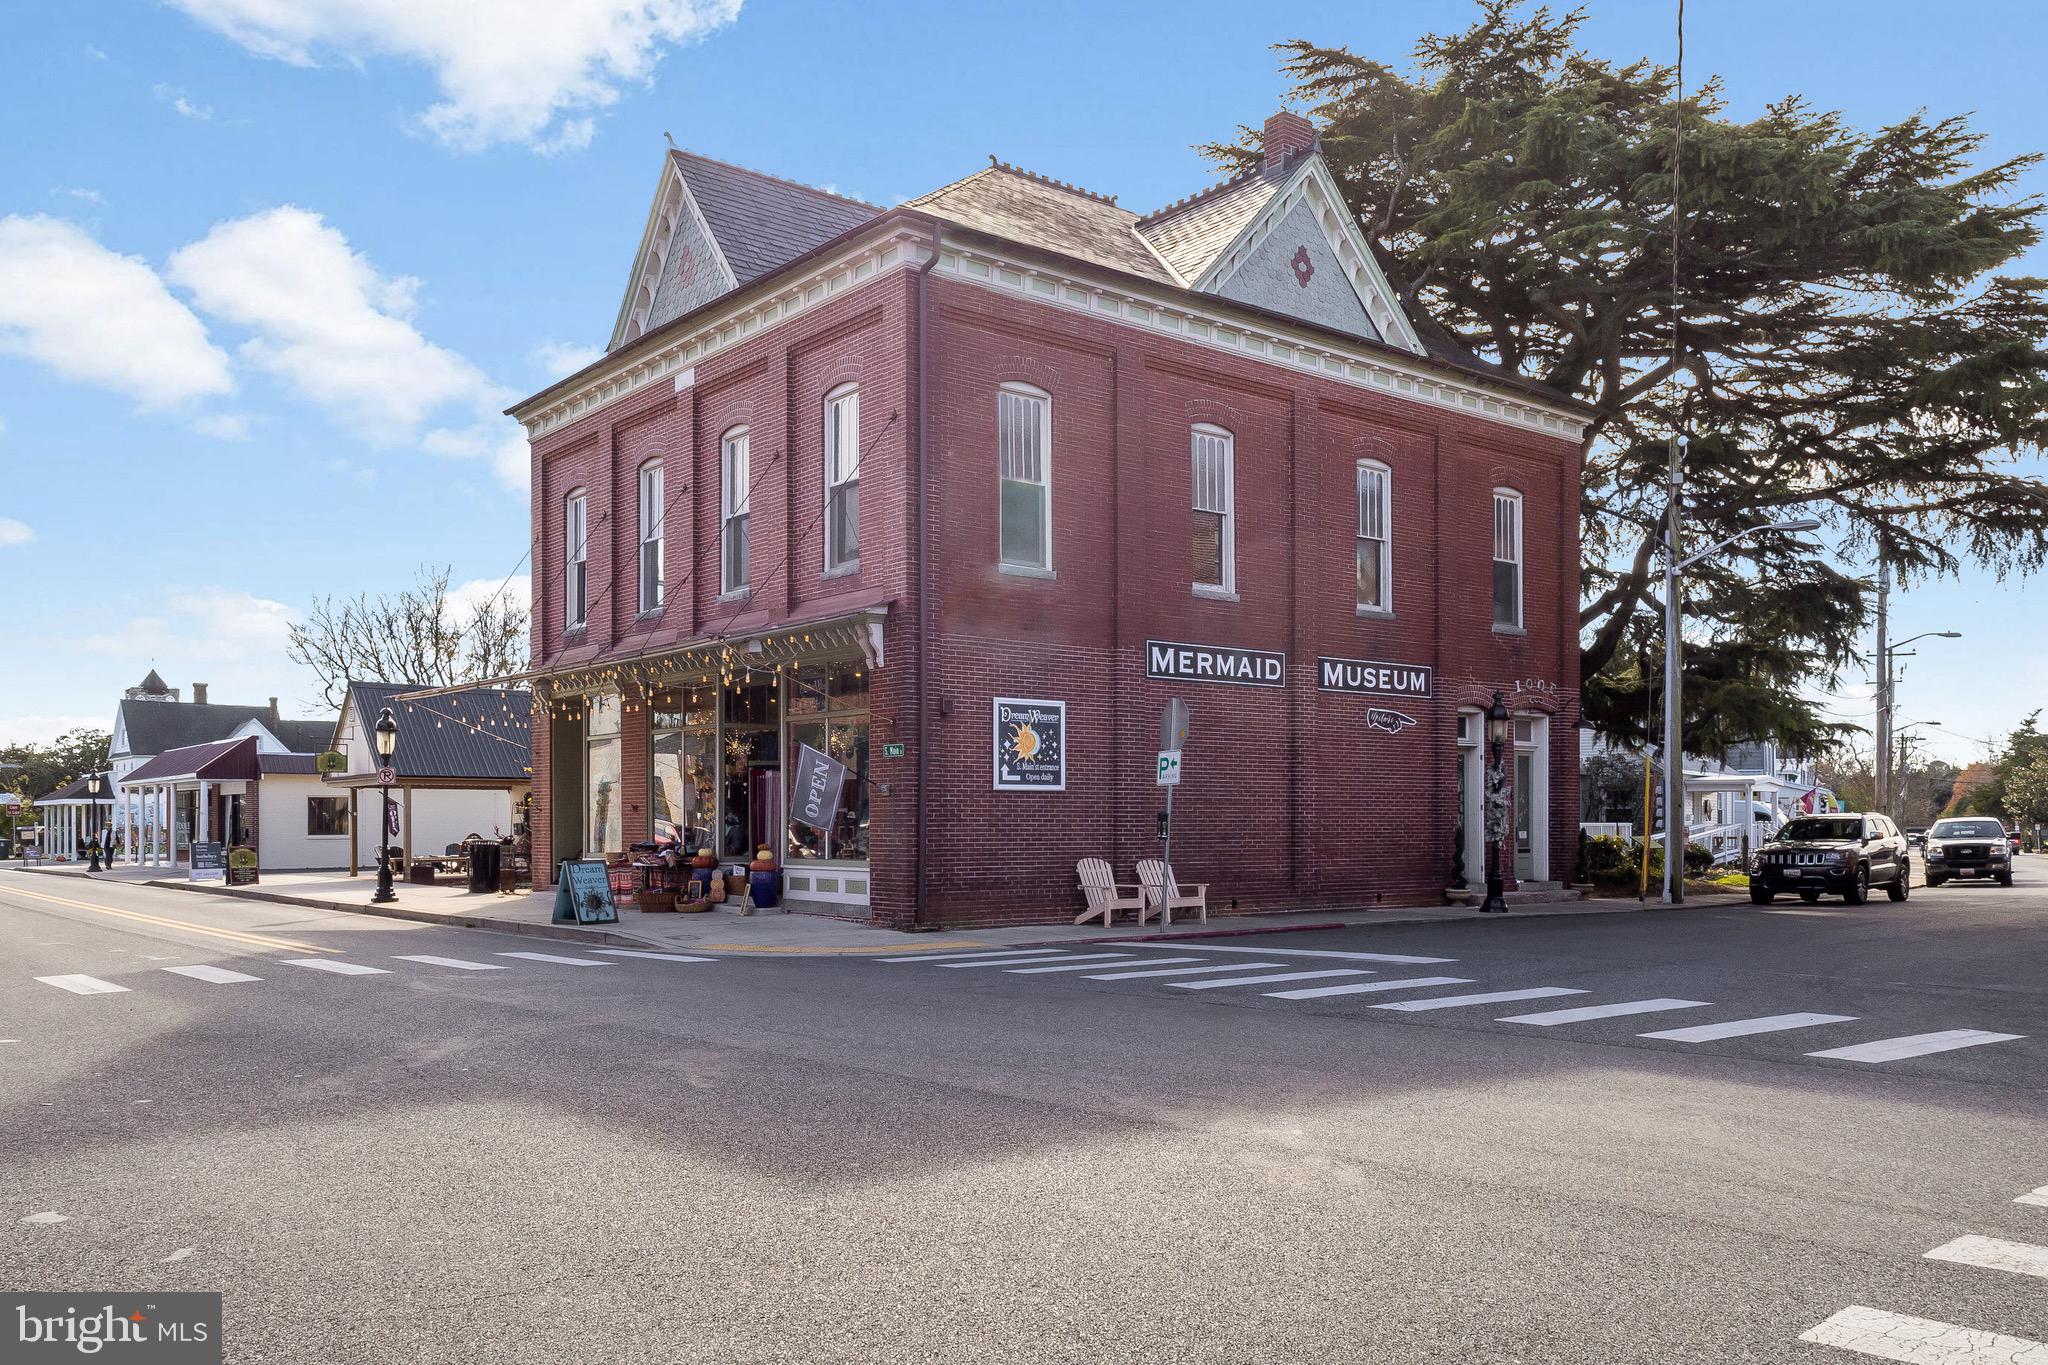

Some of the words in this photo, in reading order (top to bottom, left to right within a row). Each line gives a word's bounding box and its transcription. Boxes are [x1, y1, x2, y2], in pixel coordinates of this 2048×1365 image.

[1151, 646, 1281, 680] MERMAID
[1323, 662, 1425, 692] MUSEUM
[1000, 706, 1028, 722] Dream
[1028, 709, 1059, 724] Weaver
[1022, 762, 1035, 771] Main
[1025, 772, 1040, 782] Open
[1041, 773, 1054, 782] daily
[805, 759, 829, 818] OPEN
[572, 863, 604, 874] Dream
[572, 876, 606, 885] Weaver
